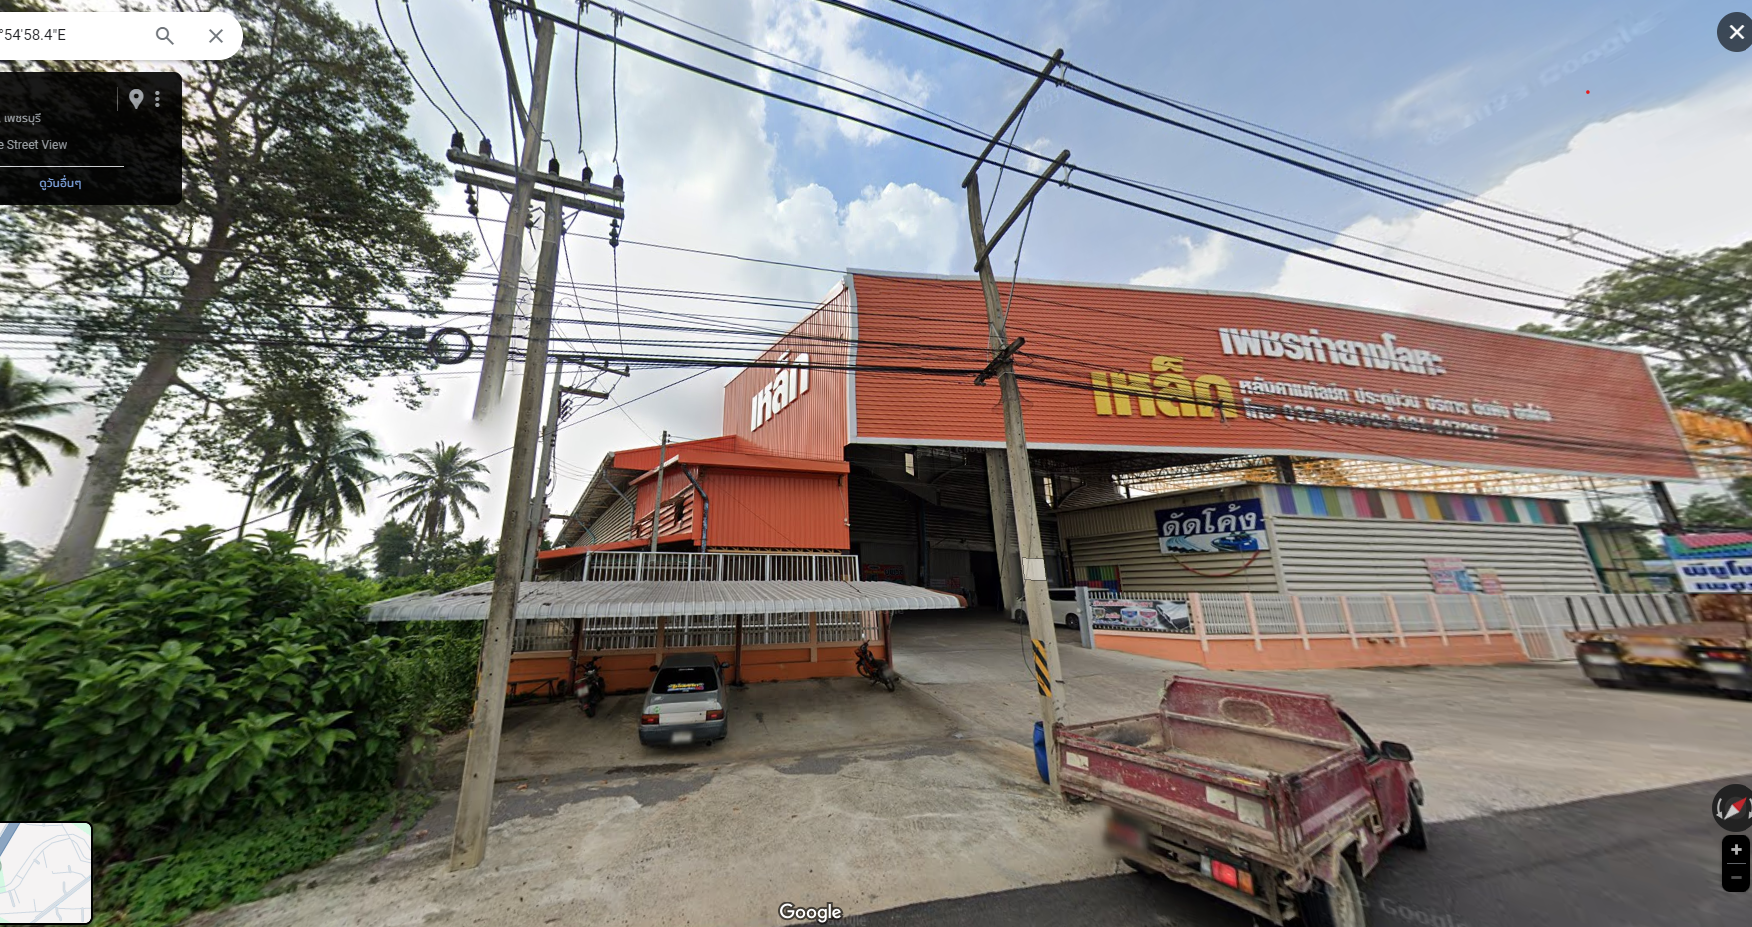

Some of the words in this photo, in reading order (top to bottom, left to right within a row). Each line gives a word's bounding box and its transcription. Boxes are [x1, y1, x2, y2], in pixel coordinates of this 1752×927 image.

[1090, 355, 1239, 419] เหล็ก
[1162, 503, 1257, 537] ดัดโค้ง
